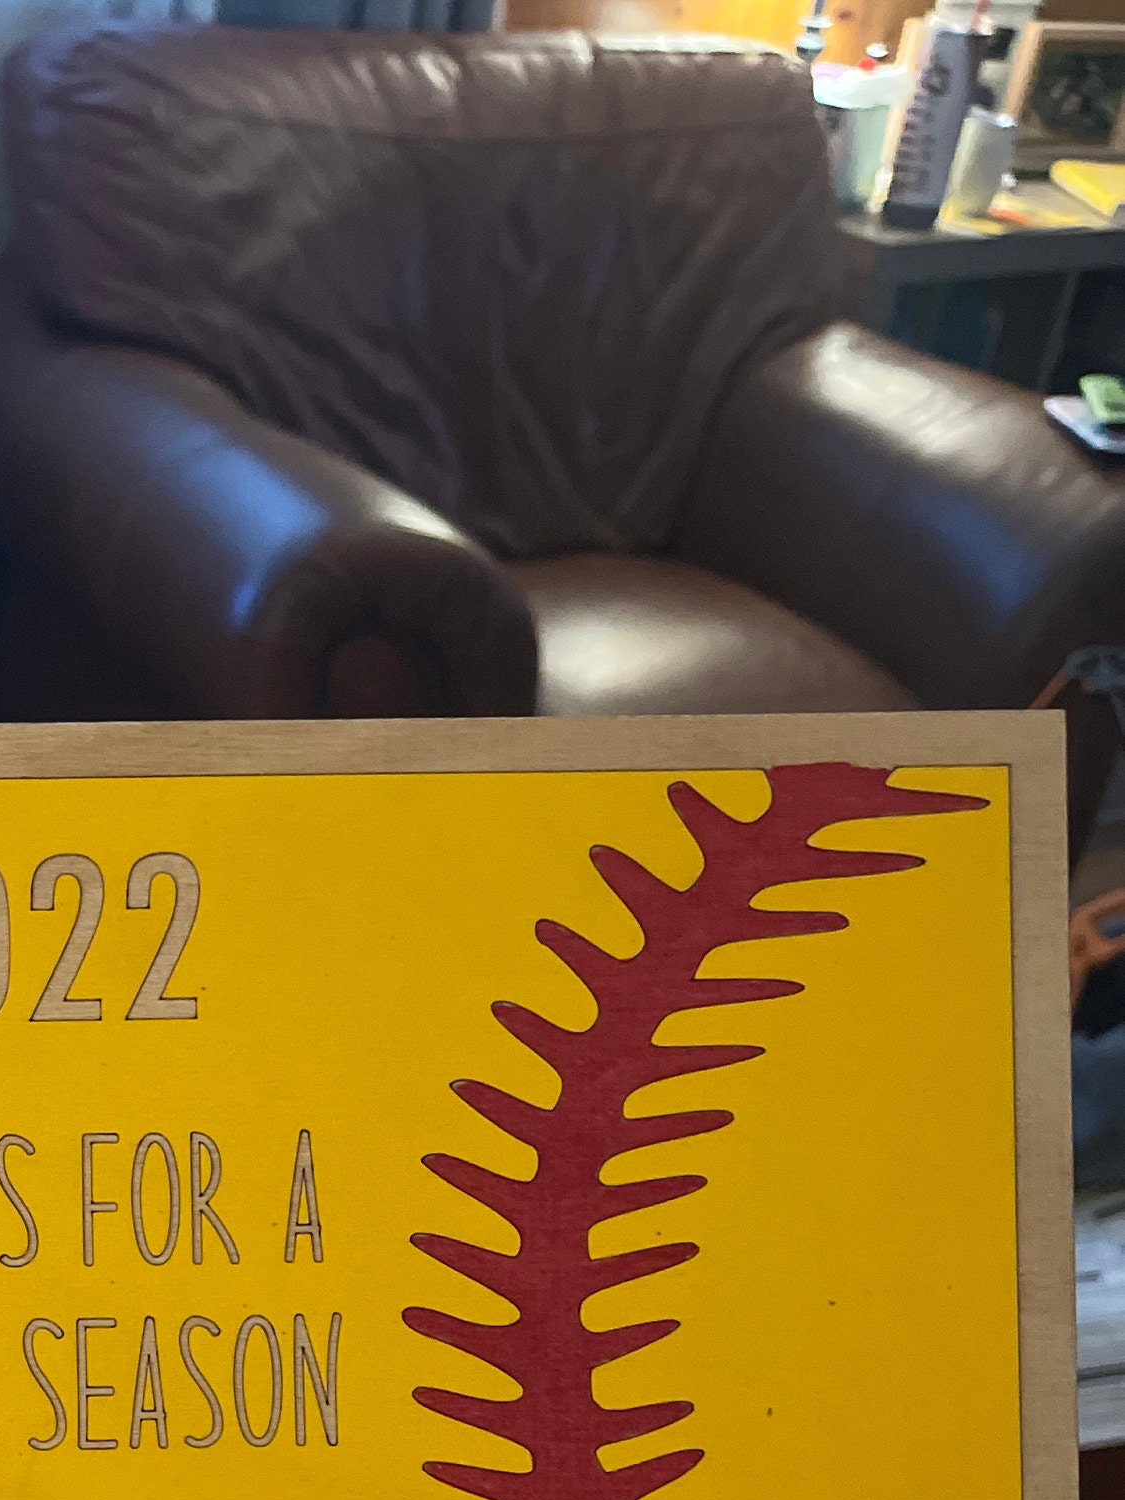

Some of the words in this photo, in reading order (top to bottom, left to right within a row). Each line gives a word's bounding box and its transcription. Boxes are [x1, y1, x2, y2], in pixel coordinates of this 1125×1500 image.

[81, 1131, 240, 1267] FOR
[284, 1129, 324, 1263] A
[22, 1312, 342, 1452] SEASON
